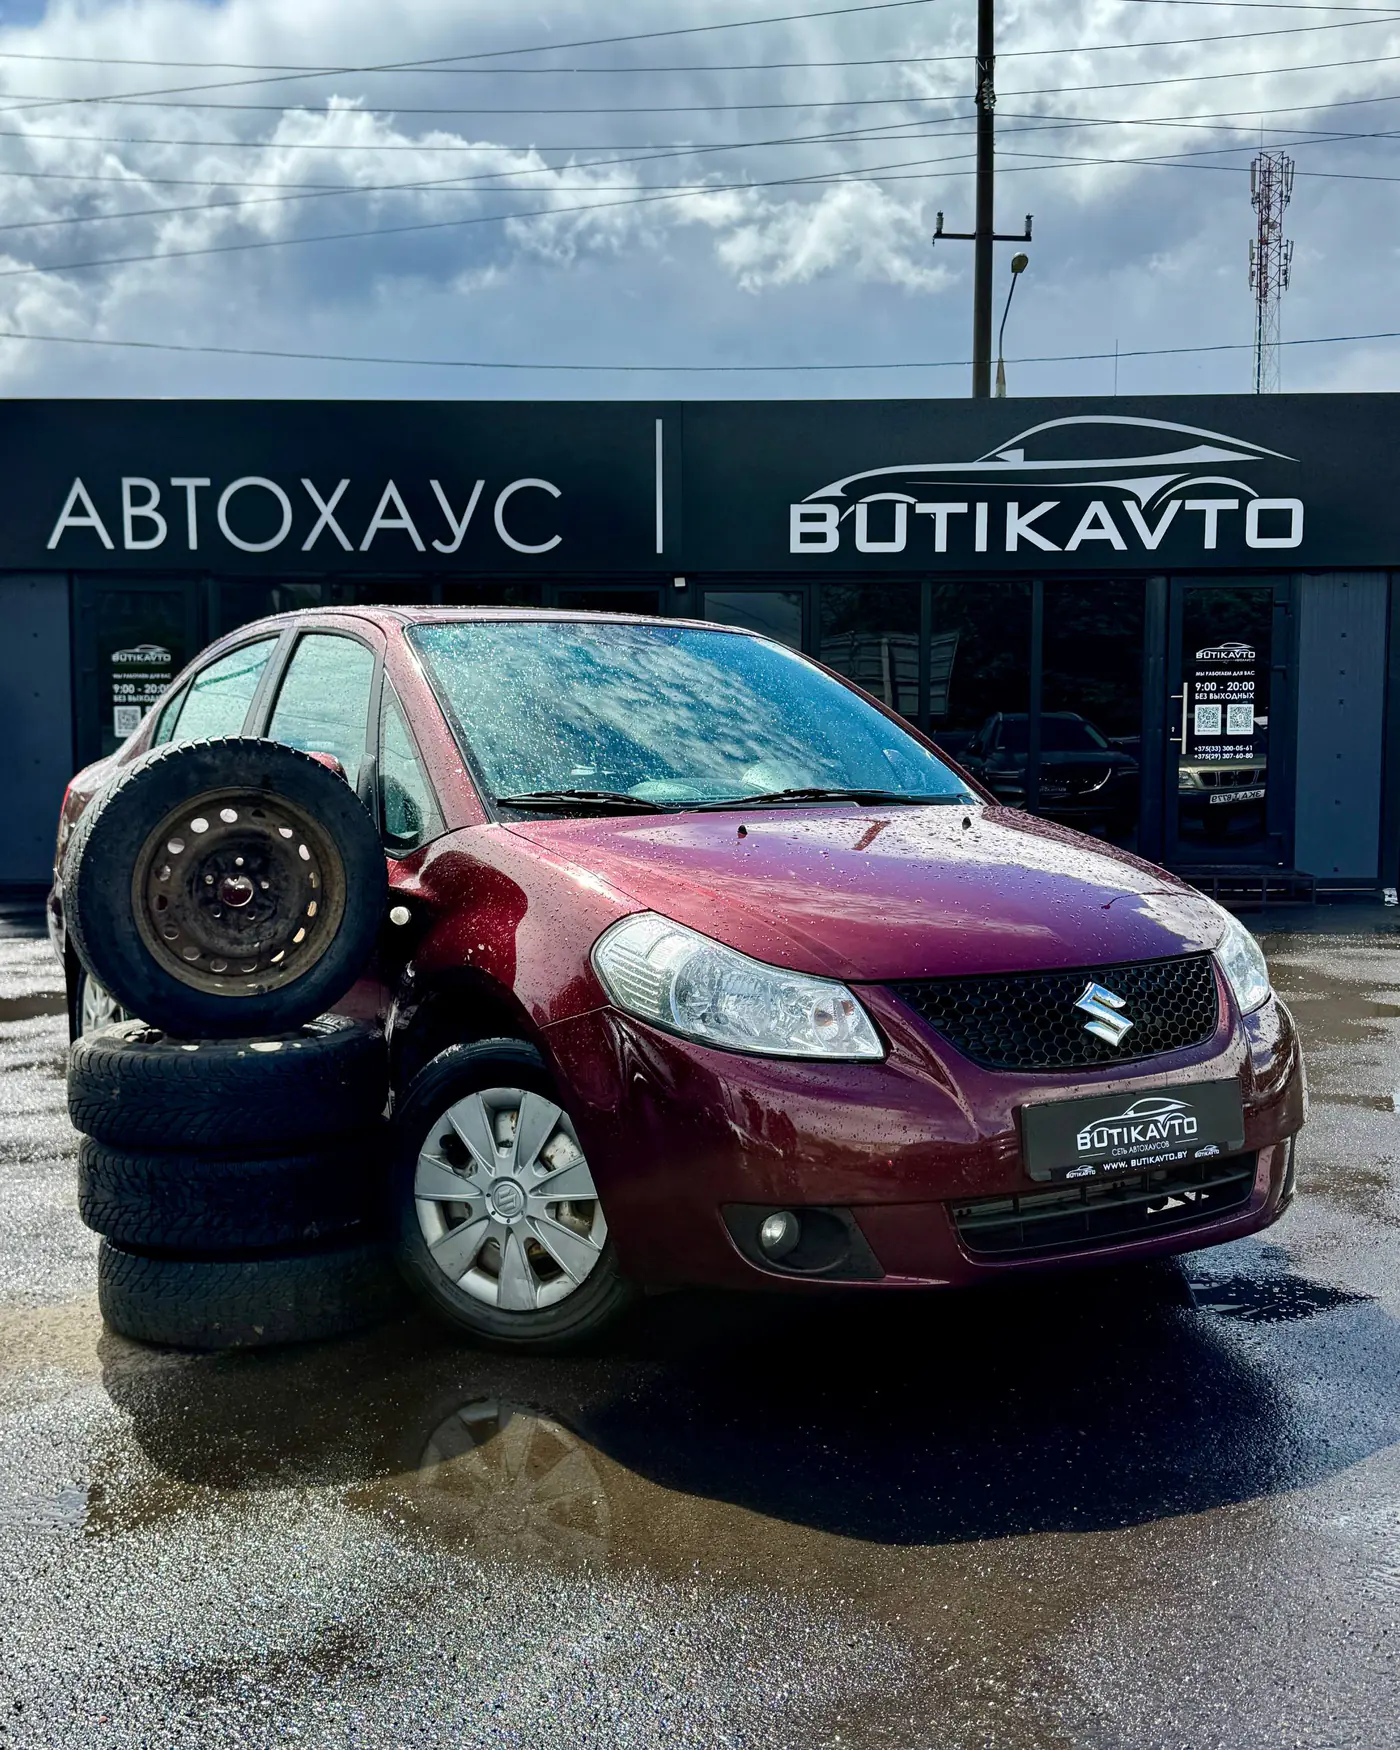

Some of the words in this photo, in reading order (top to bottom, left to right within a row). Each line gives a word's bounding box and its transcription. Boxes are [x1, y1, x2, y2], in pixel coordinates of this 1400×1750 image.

[46, 476, 563, 554] АВТОХАУС
[789, 497, 1305, 554] BUTIKAVTO
[112, 653, 171, 661] BUTIKAVTO
[1196, 651, 1256, 659] BUTIKAVTO
[113, 684, 135, 694] 9:00
[1195, 682, 1217, 691] 9:00
[1226, 681, 1255, 691] 20:00
[1194, 692, 1207, 700] БЕЗ
[1209, 692, 1255, 700] ВЫХОДНЫХ
[1076, 1117, 1198, 1151] BUTIKAVTO
[1111, 1147, 1128, 1156] СЕТЬ
[1128, 1140, 1170, 1154] АВТОХАУСОВ
[1066, 1169, 1096, 1179] BUTIKAVTO
[1103, 1161, 1128, 1171] WWW.
[1130, 1150, 1188, 1167] BUTIKAVTO.BY
[1194, 1149, 1220, 1158] BUTIKAVTO
